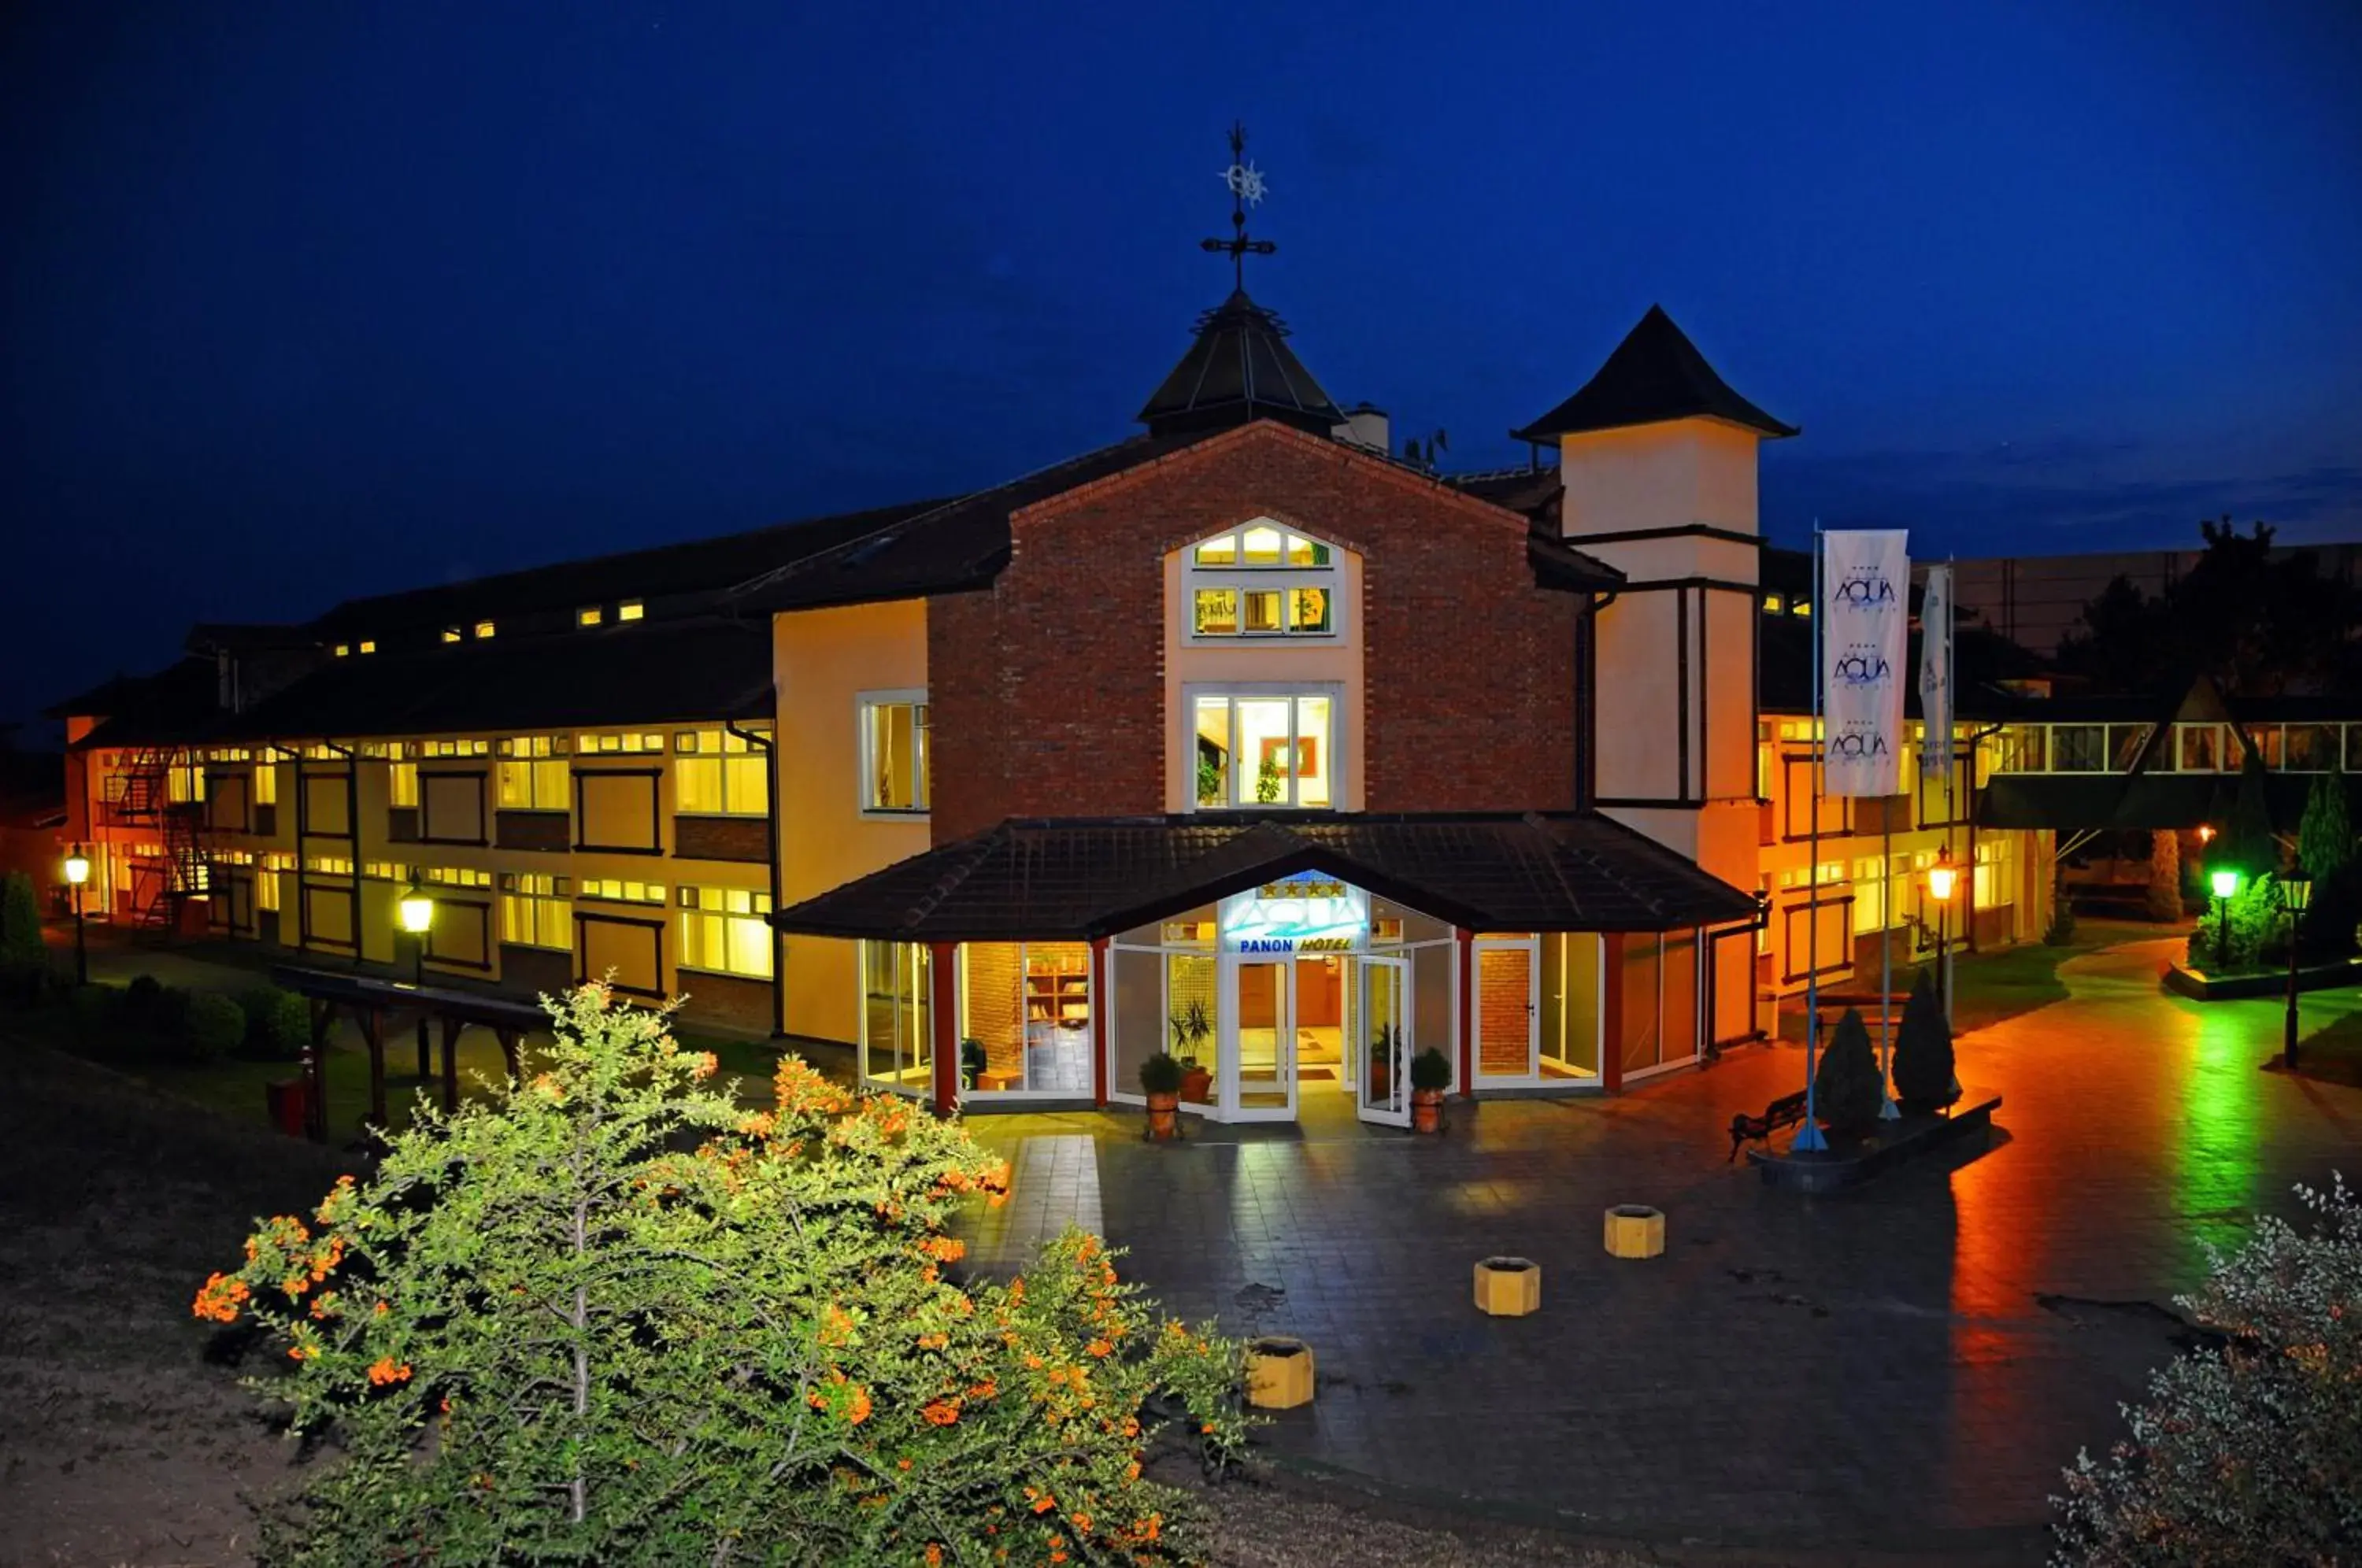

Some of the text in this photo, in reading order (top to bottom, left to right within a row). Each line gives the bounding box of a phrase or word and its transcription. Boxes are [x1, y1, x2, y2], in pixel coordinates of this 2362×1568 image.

[1834, 580, 1895, 603] AQUA
[1834, 657, 1890, 680] AQUA
[1831, 734, 1888, 757] AQUA
[1240, 937, 1351, 952] PANON HOTEL
